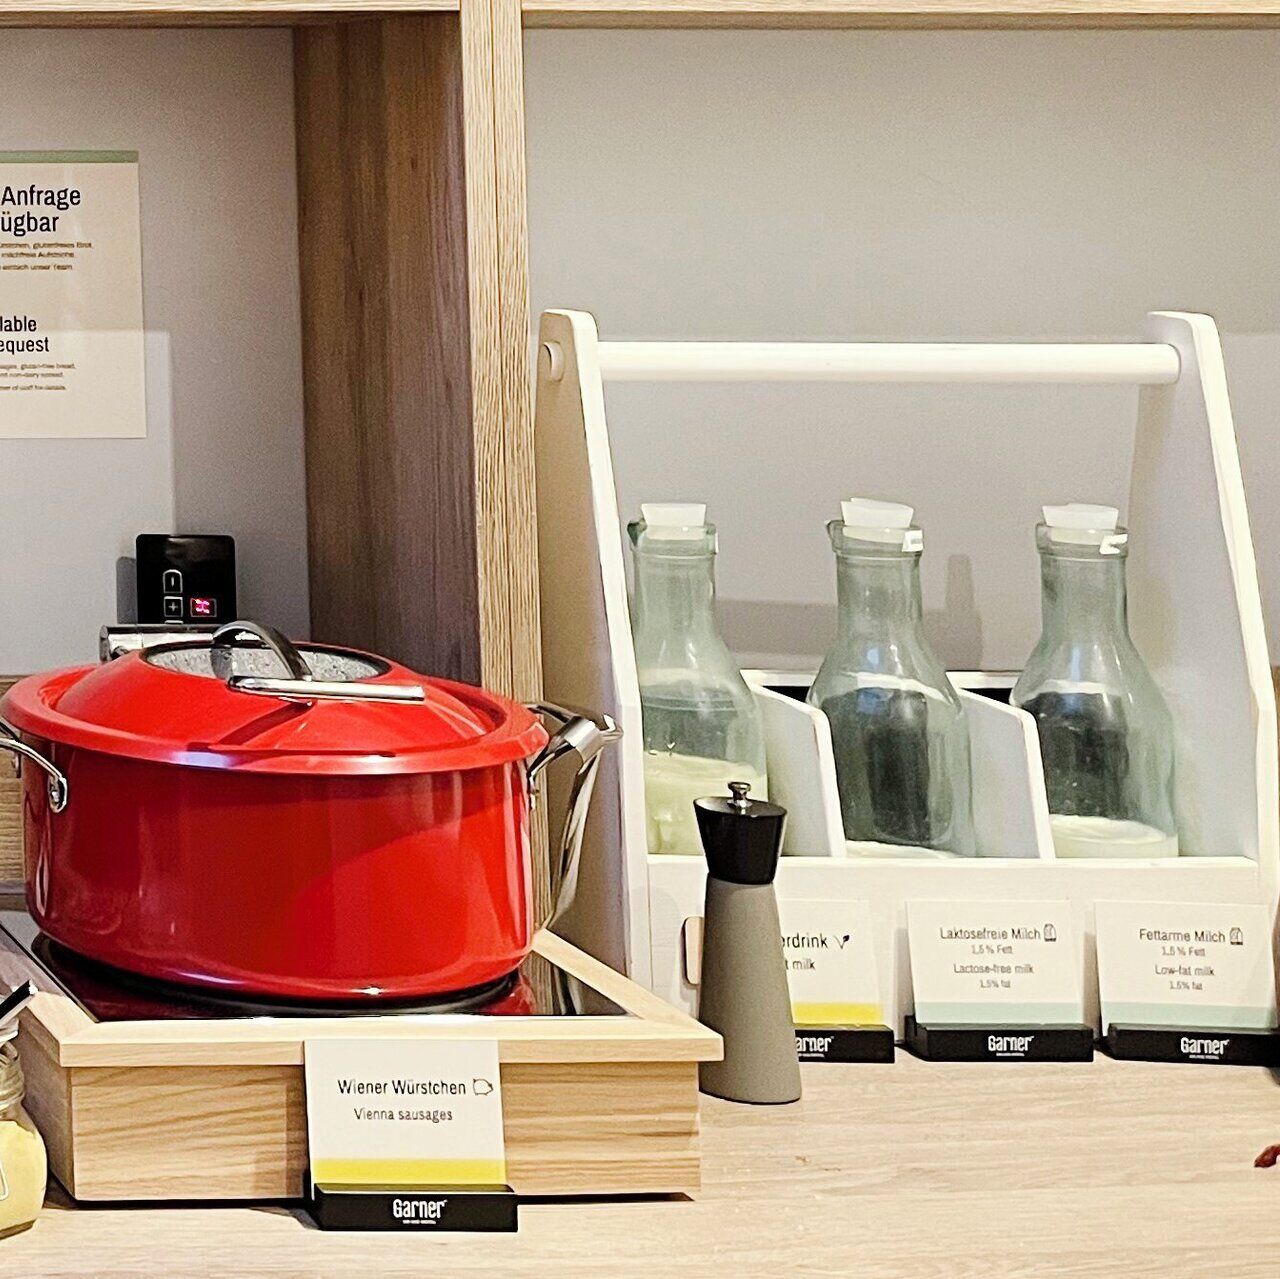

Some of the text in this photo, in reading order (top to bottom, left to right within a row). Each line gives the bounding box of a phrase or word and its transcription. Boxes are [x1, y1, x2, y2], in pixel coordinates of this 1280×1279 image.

[1, 184, 81, 210] Anfrage
[940, 926, 1040, 940] Laktosefreie Milch
[1140, 928, 1226, 943] Fettarme Milch
[792, 958, 816, 970] milk
[954, 963, 1034, 974] Lactose-free milk
[1155, 964, 1215, 976] Low-fat milk
[795, 1037, 832, 1052] arner
[988, 1035, 1033, 1051] Garner
[1180, 1037, 1228, 1055] Garner
[338, 1078, 466, 1095] Wiener Würstchen
[354, 1107, 453, 1123] Vienna sausages
[393, 1199, 445, 1218] Garner
